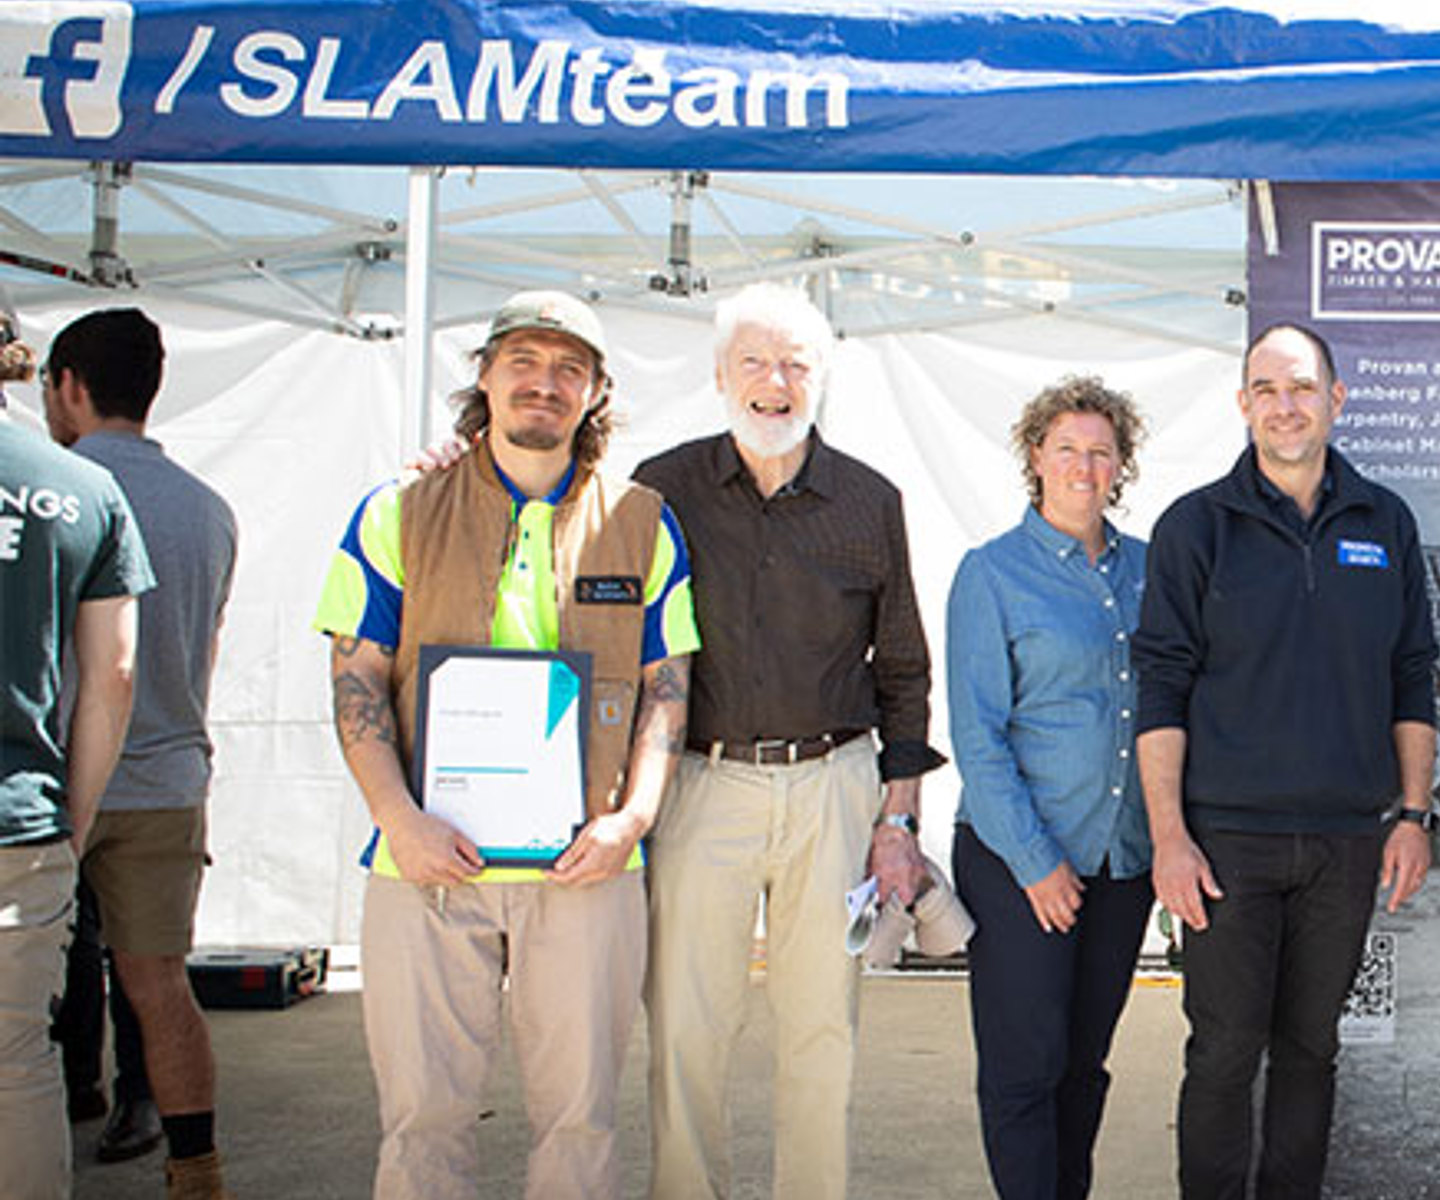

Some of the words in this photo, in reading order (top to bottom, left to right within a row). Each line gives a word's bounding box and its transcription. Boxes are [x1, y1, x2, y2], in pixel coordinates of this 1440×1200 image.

[1357, 359, 1427, 375] Provan
[1348, 385, 1421, 403] enberg
[1333, 412, 1425, 430] arpentry,
[1335, 437, 1414, 454] Cabinet
